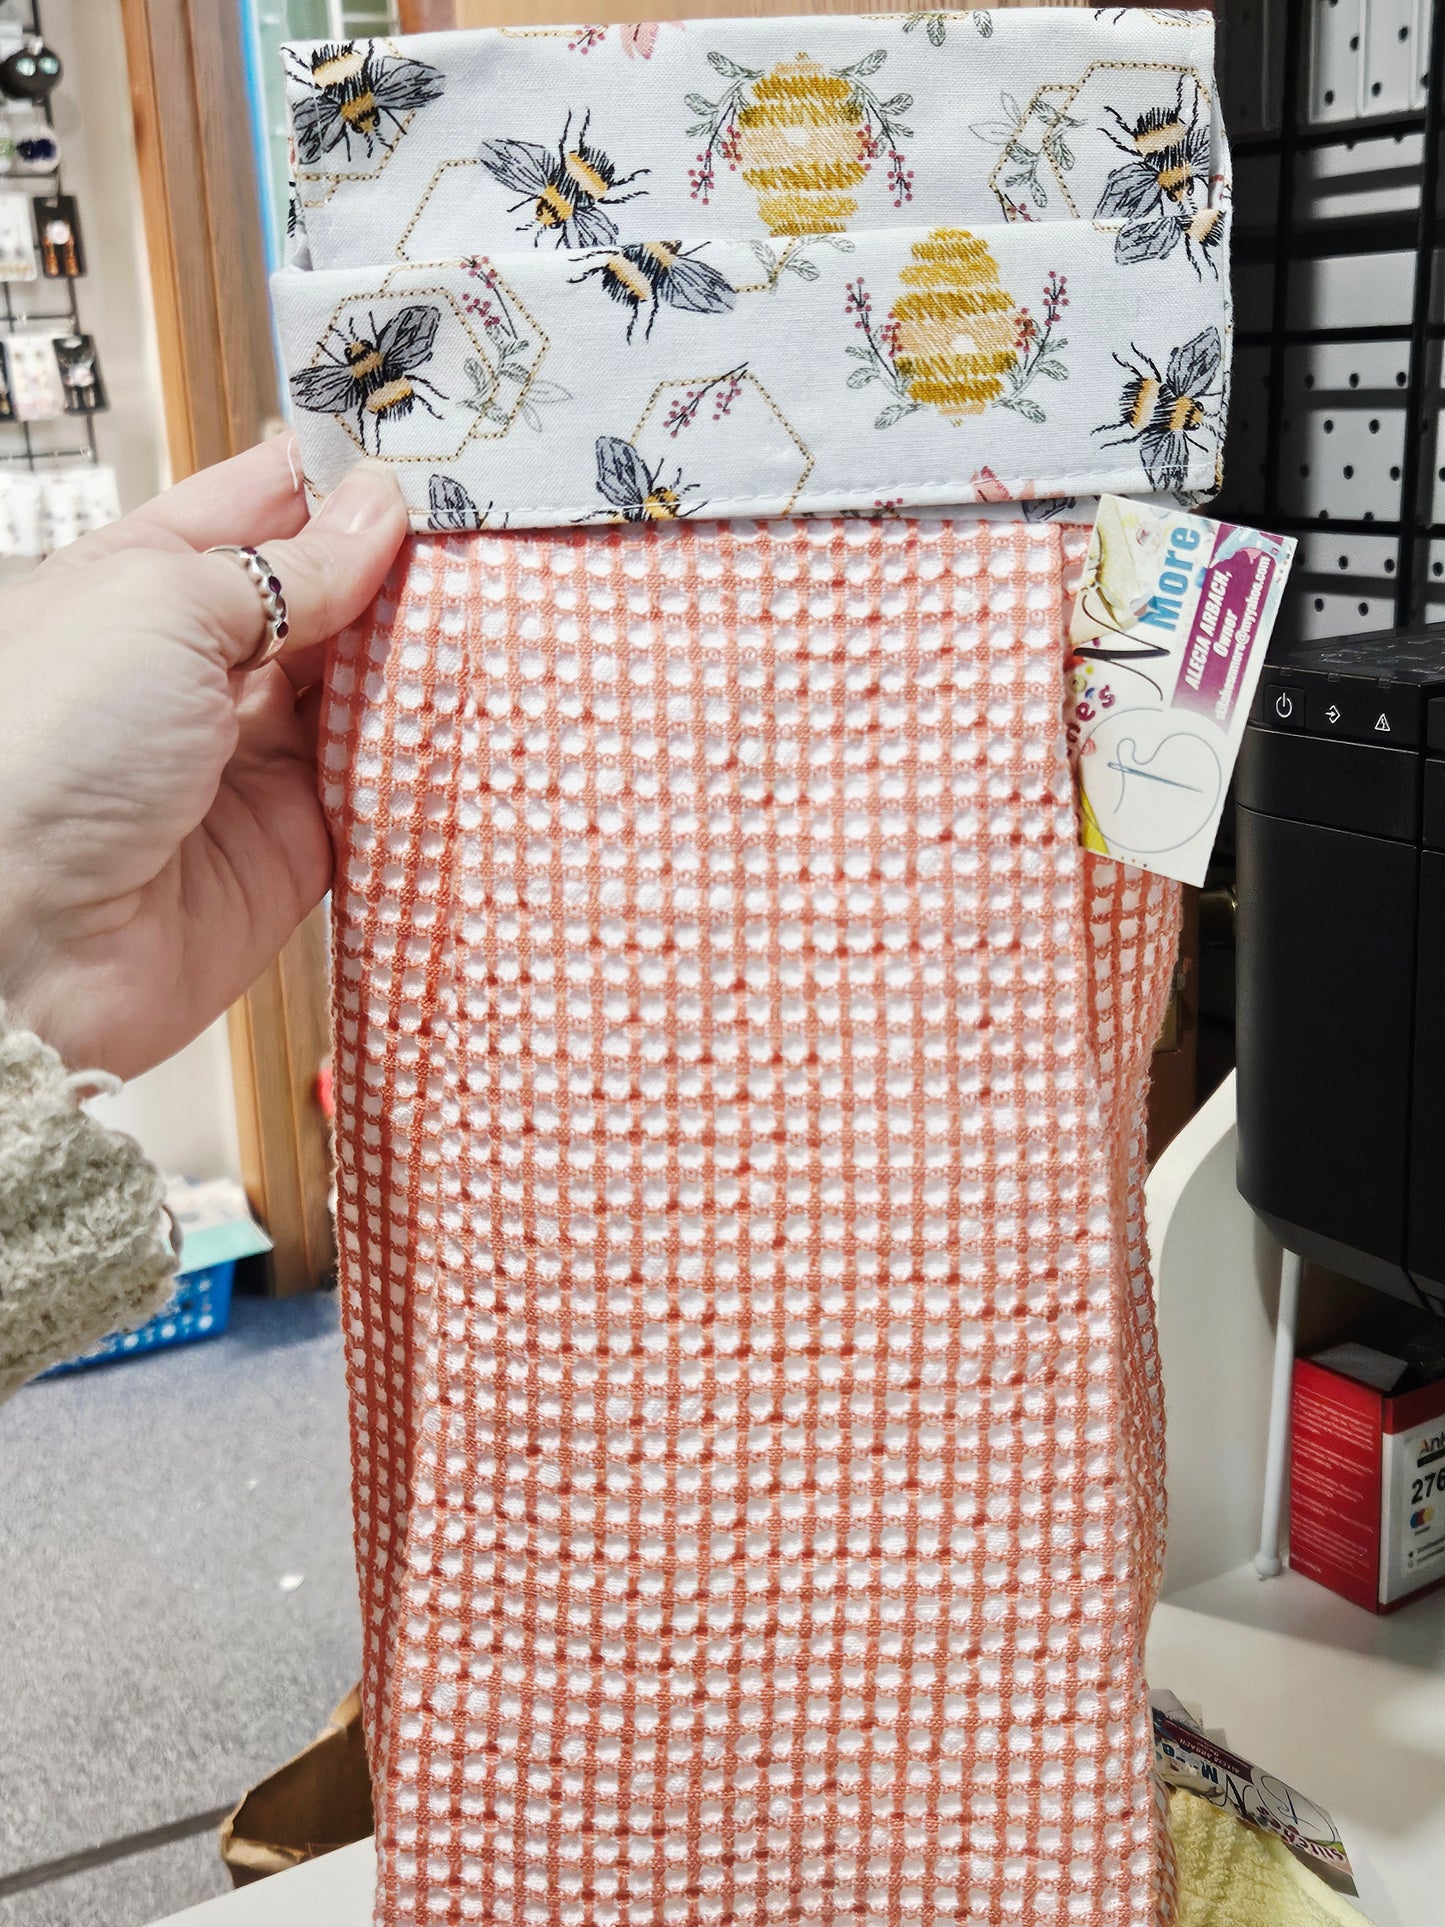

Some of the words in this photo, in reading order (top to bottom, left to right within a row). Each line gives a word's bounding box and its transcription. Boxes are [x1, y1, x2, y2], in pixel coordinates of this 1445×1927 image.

[1139, 526, 1201, 632] More
[1184, 635, 1212, 691] ALECIA
[1200, 569, 1233, 637] ARBACH,
[1214, 608, 1239, 658] Owner
